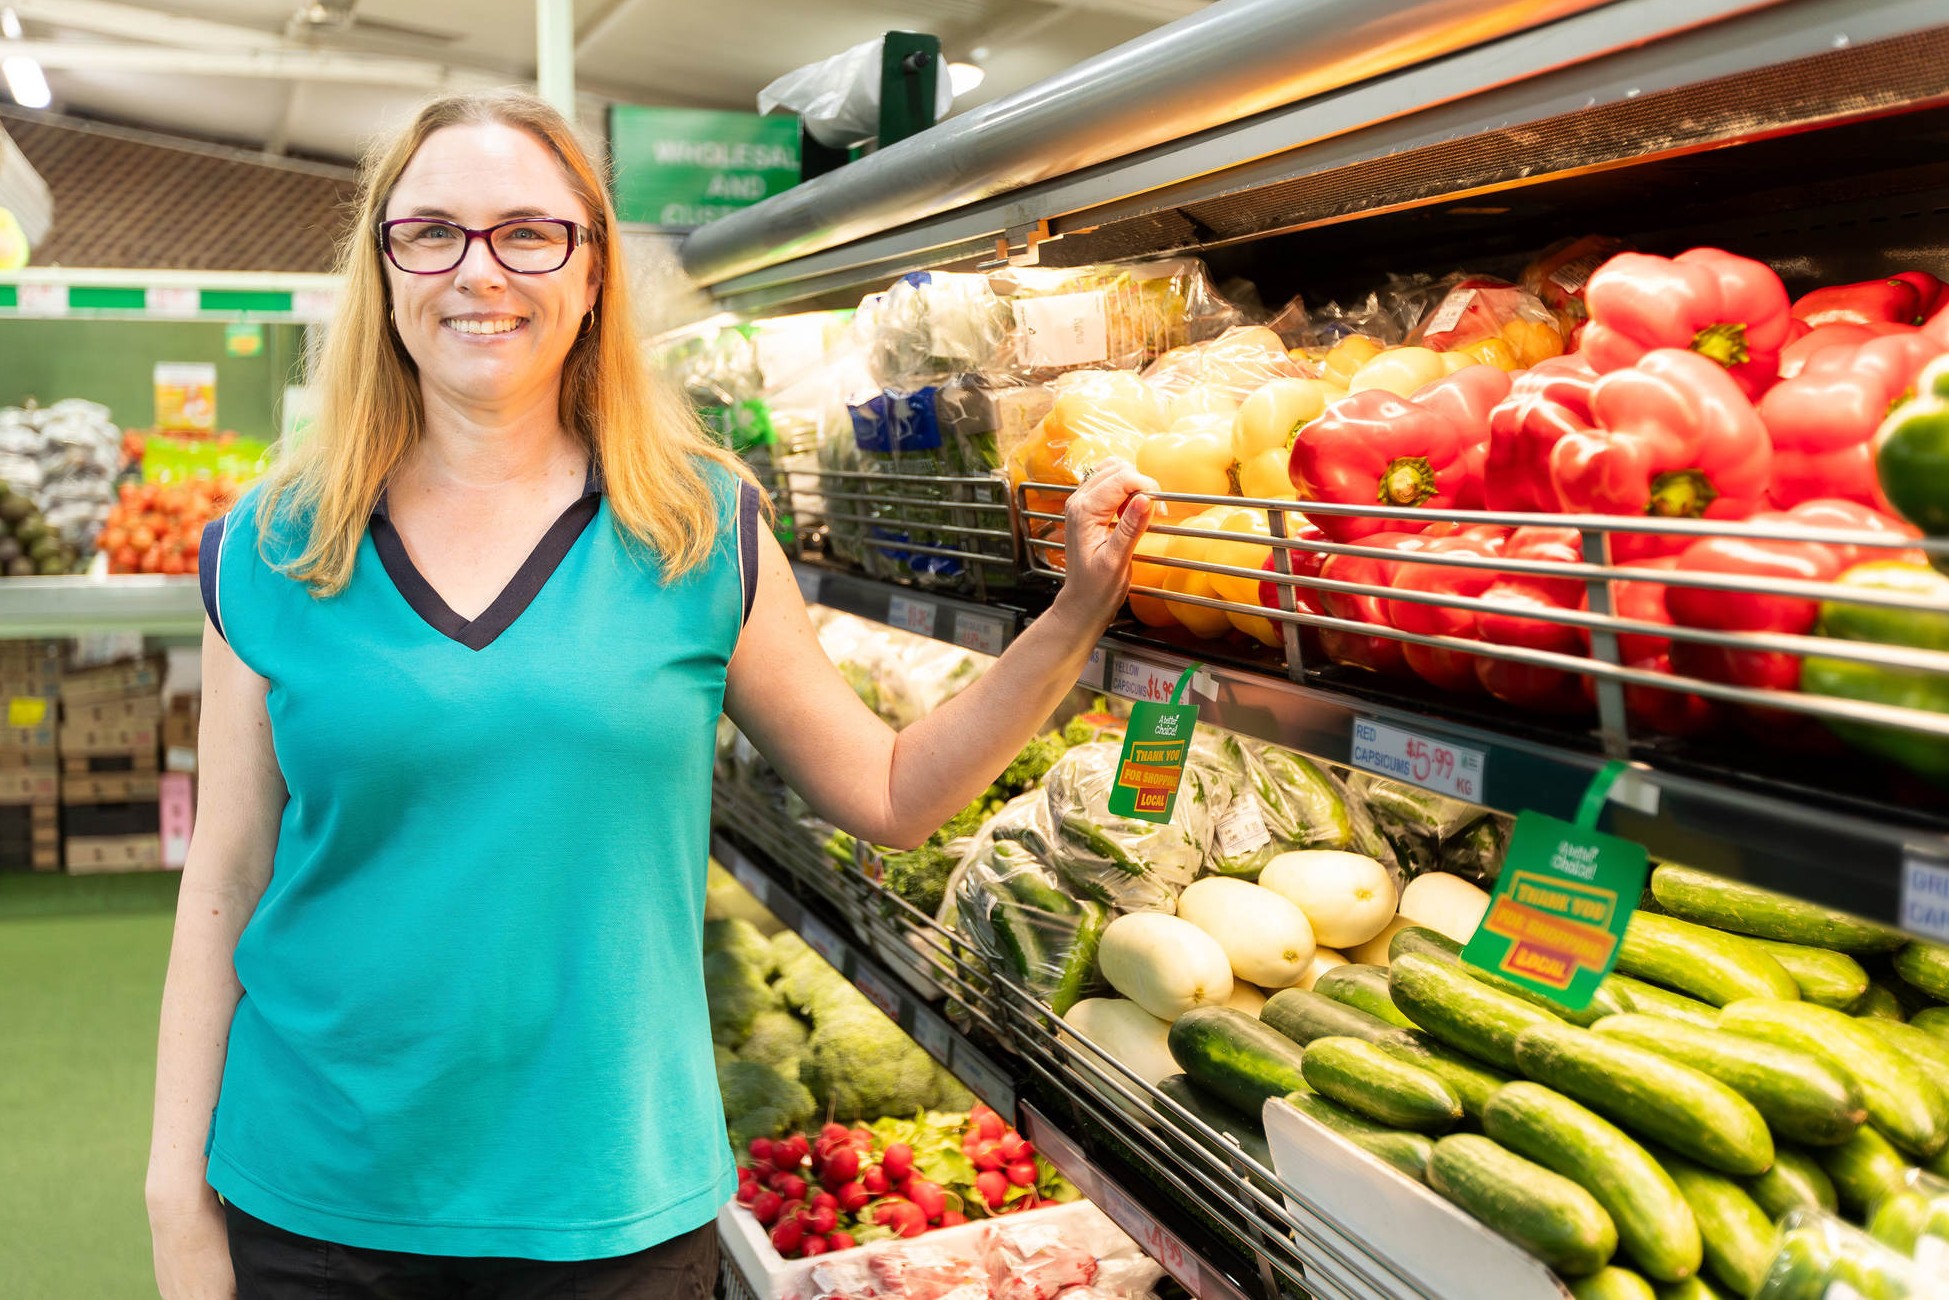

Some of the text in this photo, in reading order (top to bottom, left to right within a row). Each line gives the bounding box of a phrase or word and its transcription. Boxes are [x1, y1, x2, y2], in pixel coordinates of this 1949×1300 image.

[706, 174, 766, 198] AND
[1115, 660, 1140, 676] YELLOW
[1112, 678, 1147, 698] CAPSICUMS
[1356, 724, 1377, 742] RED
[1136, 749, 1181, 763] THANK YOU
[1354, 736, 1455, 782] CAPSICUMS $5.99
[1124, 768, 1142, 782] FOR
[1456, 777, 1473, 796] KG
[1140, 793, 1165, 808] LOCAL
[1517, 883, 1607, 921] THANK YOU
[1514, 947, 1567, 979] LOCAL
